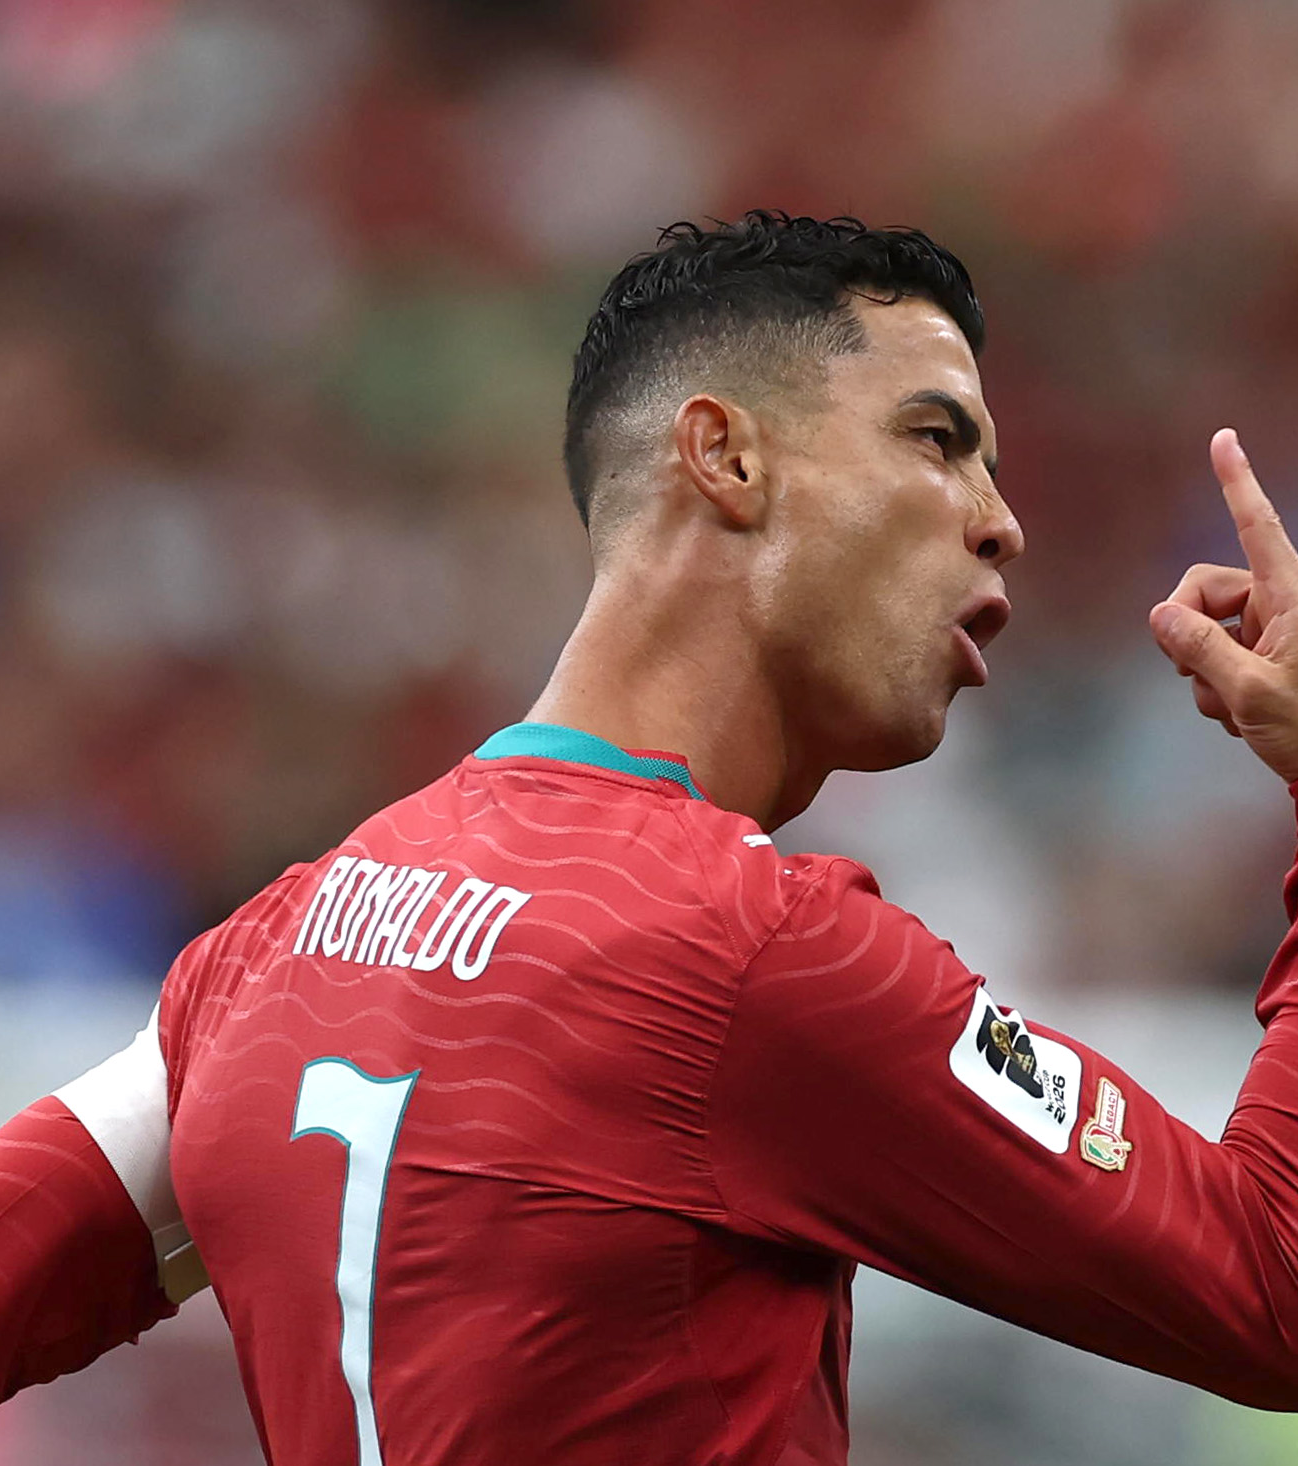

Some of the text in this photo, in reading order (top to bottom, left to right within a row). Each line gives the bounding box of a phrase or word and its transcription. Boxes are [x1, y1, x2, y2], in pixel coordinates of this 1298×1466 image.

[292, 855, 533, 981] RONALDO
[1052, 1074, 1066, 1125] 2026
[1105, 1089, 1117, 1129] LEGACY
